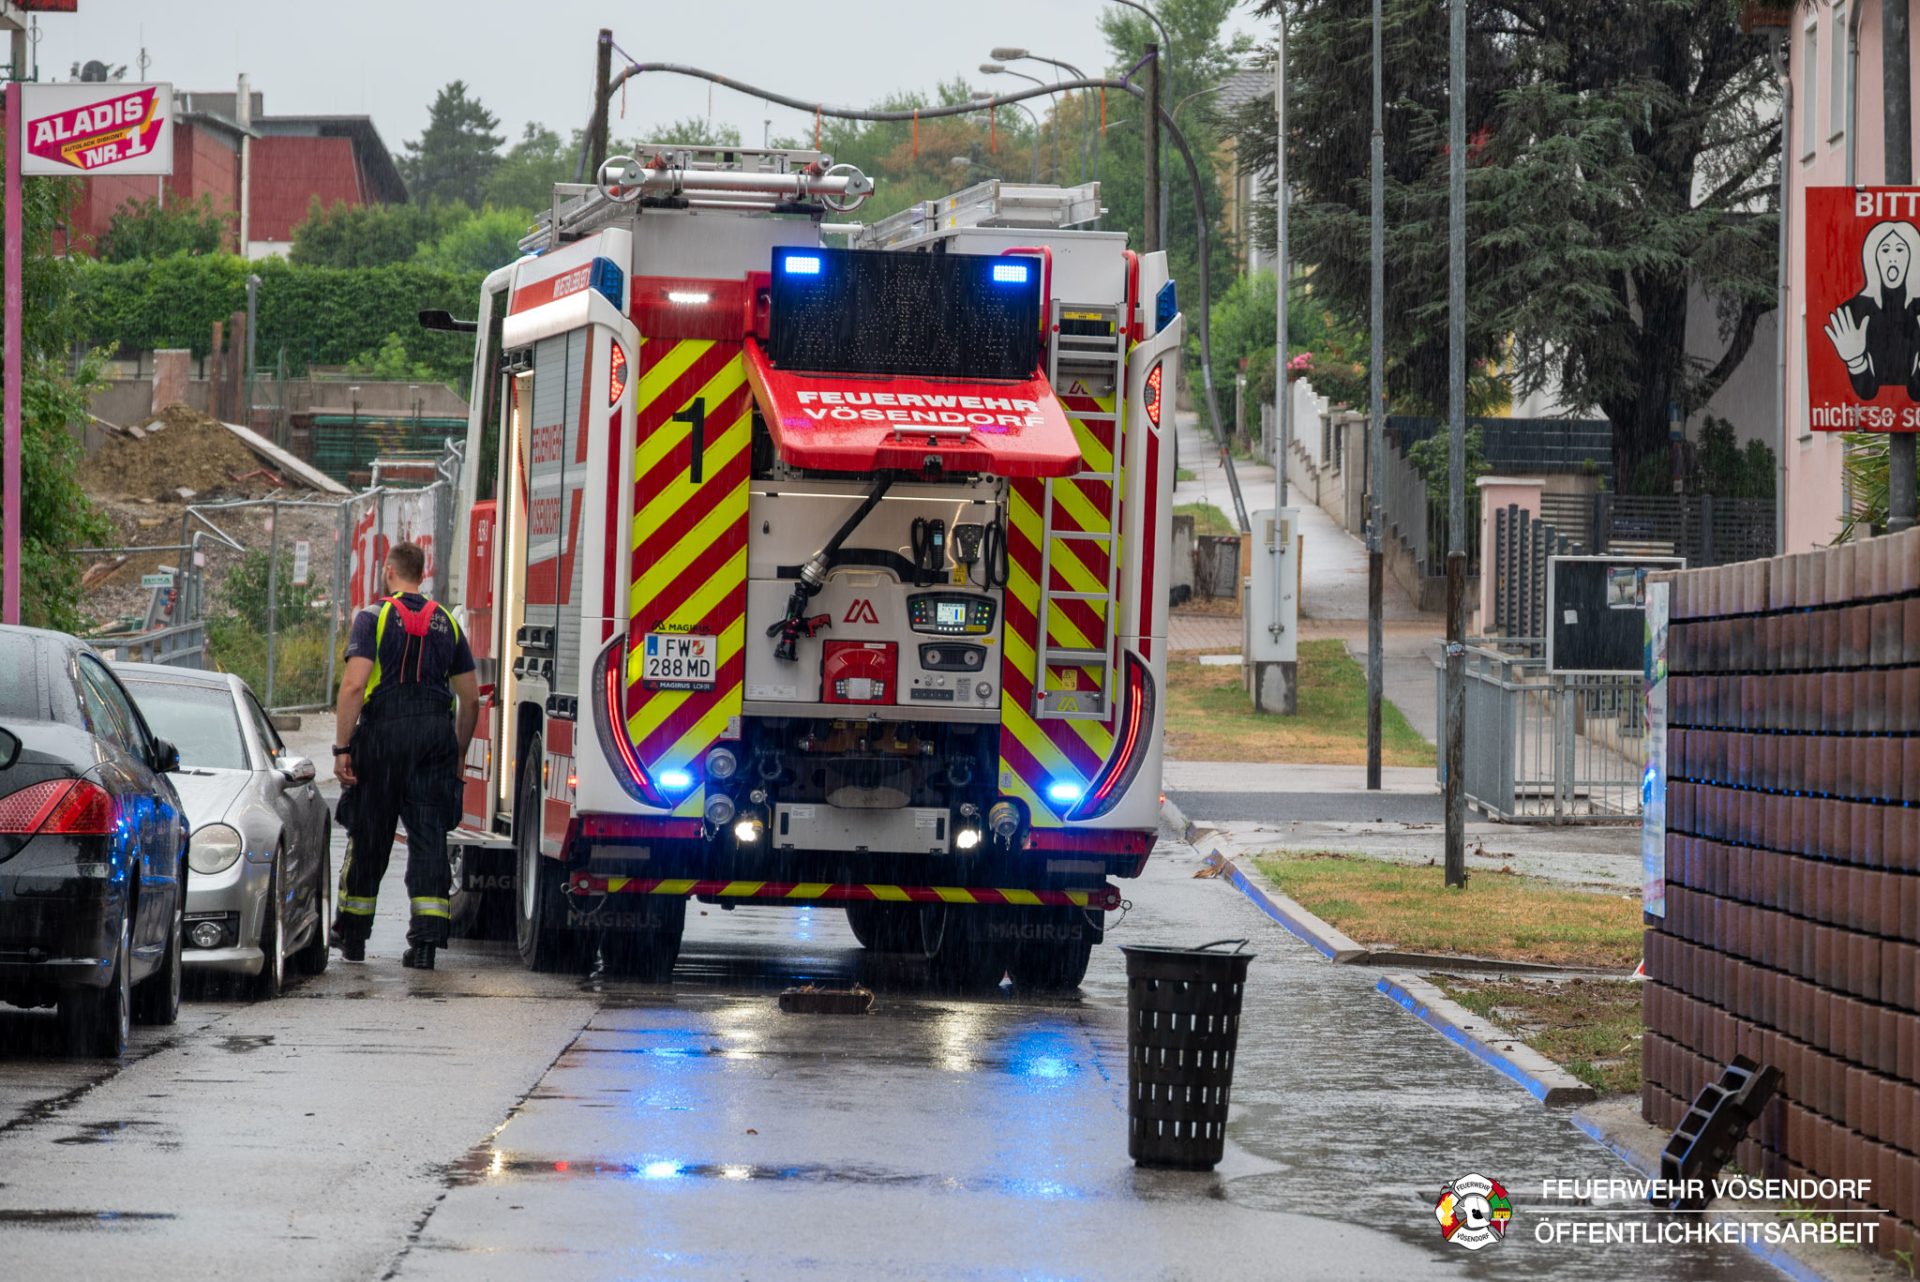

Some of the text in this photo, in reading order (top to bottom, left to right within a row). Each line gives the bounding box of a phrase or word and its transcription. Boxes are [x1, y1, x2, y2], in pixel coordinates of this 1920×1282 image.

[34, 97, 142, 146] ALADIS
[84, 125, 146, 167] NR. 1
[796, 391, 1040, 412] FEUERWEHR
[804, 407, 1045, 427] VÖSENDORF
[672, 397, 705, 483] 1
[668, 623, 710, 632] MAGIRUS
[666, 639, 691, 657] FW
[649, 658, 710, 677] 288 MD
[469, 874, 517, 889] MAGI
[566, 910, 663, 929] MAGIRUS
[988, 923, 1082, 940] MAGIRUS
